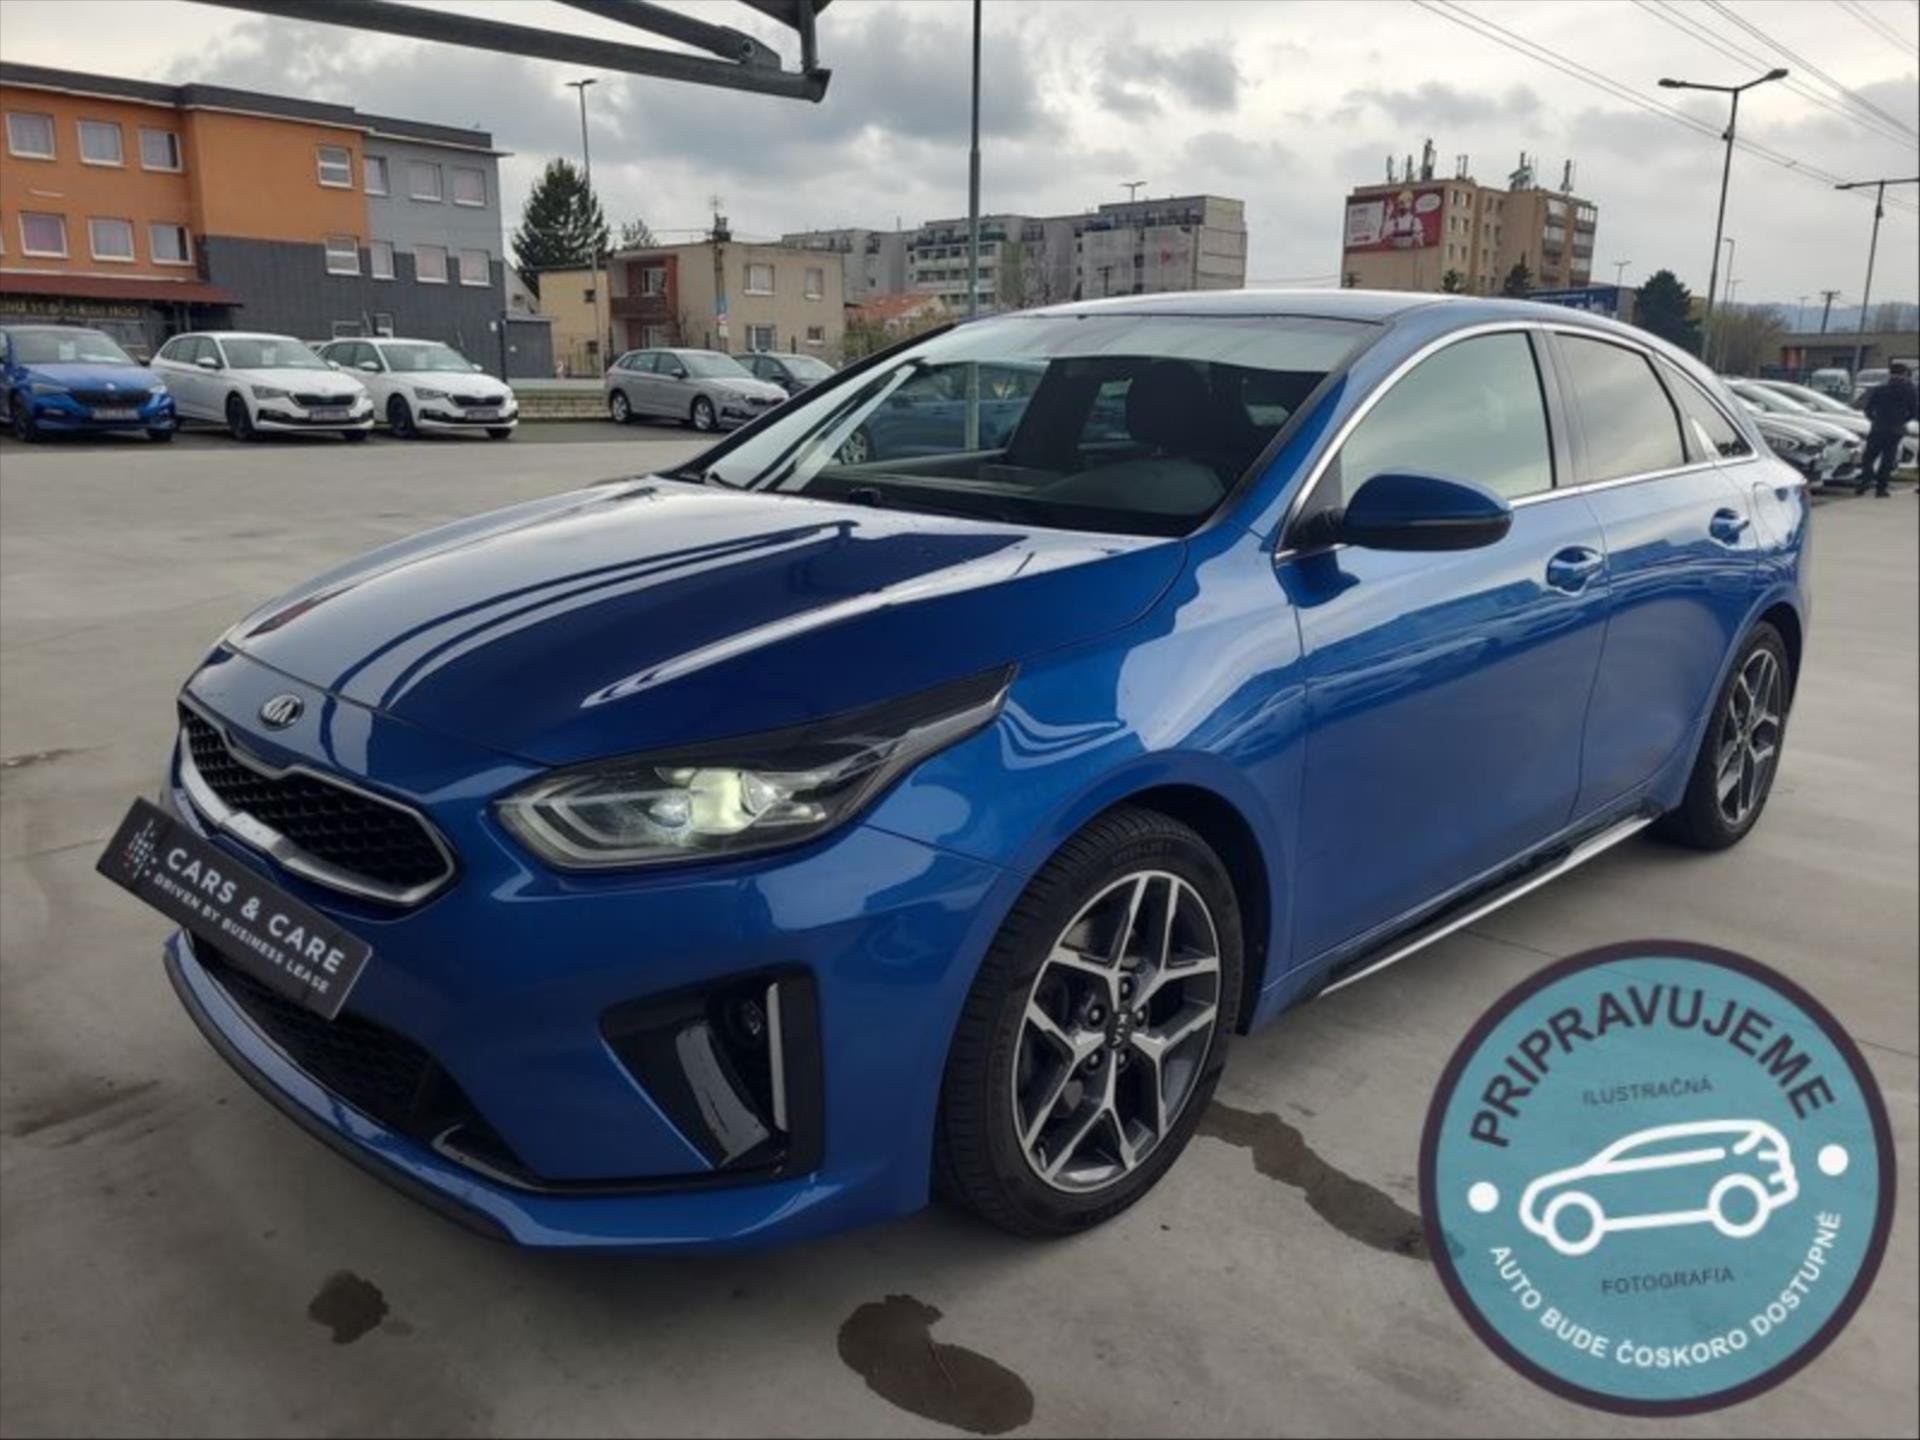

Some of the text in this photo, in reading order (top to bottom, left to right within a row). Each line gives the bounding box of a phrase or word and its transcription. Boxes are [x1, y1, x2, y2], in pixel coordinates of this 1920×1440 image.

[154, 871, 330, 994] DRIVEN BY BUSINESS LEASE
[167, 848, 345, 973] CARS & CARE
